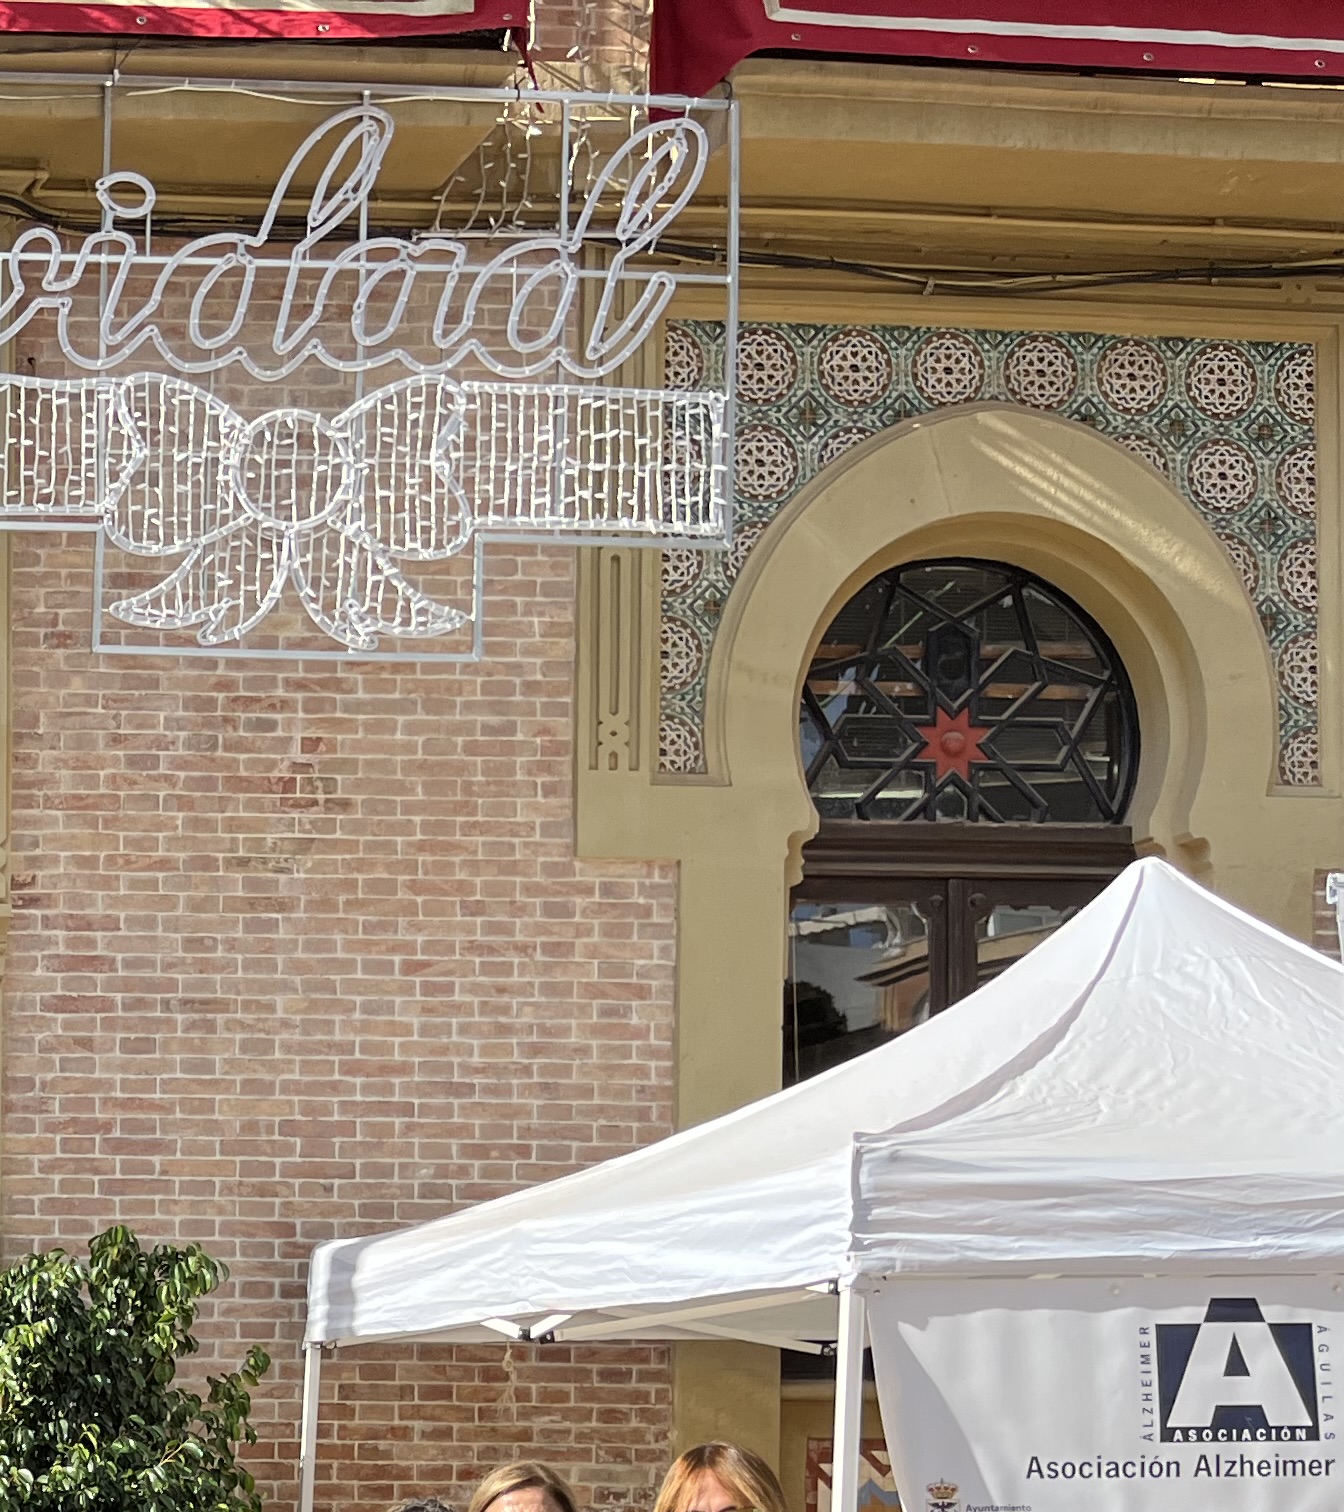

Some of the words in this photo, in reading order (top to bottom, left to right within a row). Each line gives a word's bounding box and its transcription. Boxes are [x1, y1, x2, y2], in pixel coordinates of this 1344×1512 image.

[1173, 1425, 1307, 1442] ASOCIACIÓN
[1026, 1455, 1181, 1479] Asociación
[1193, 1453, 1336, 1478] Alzheimer
[965, 1503, 1032, 1512] Ayuntamiento
